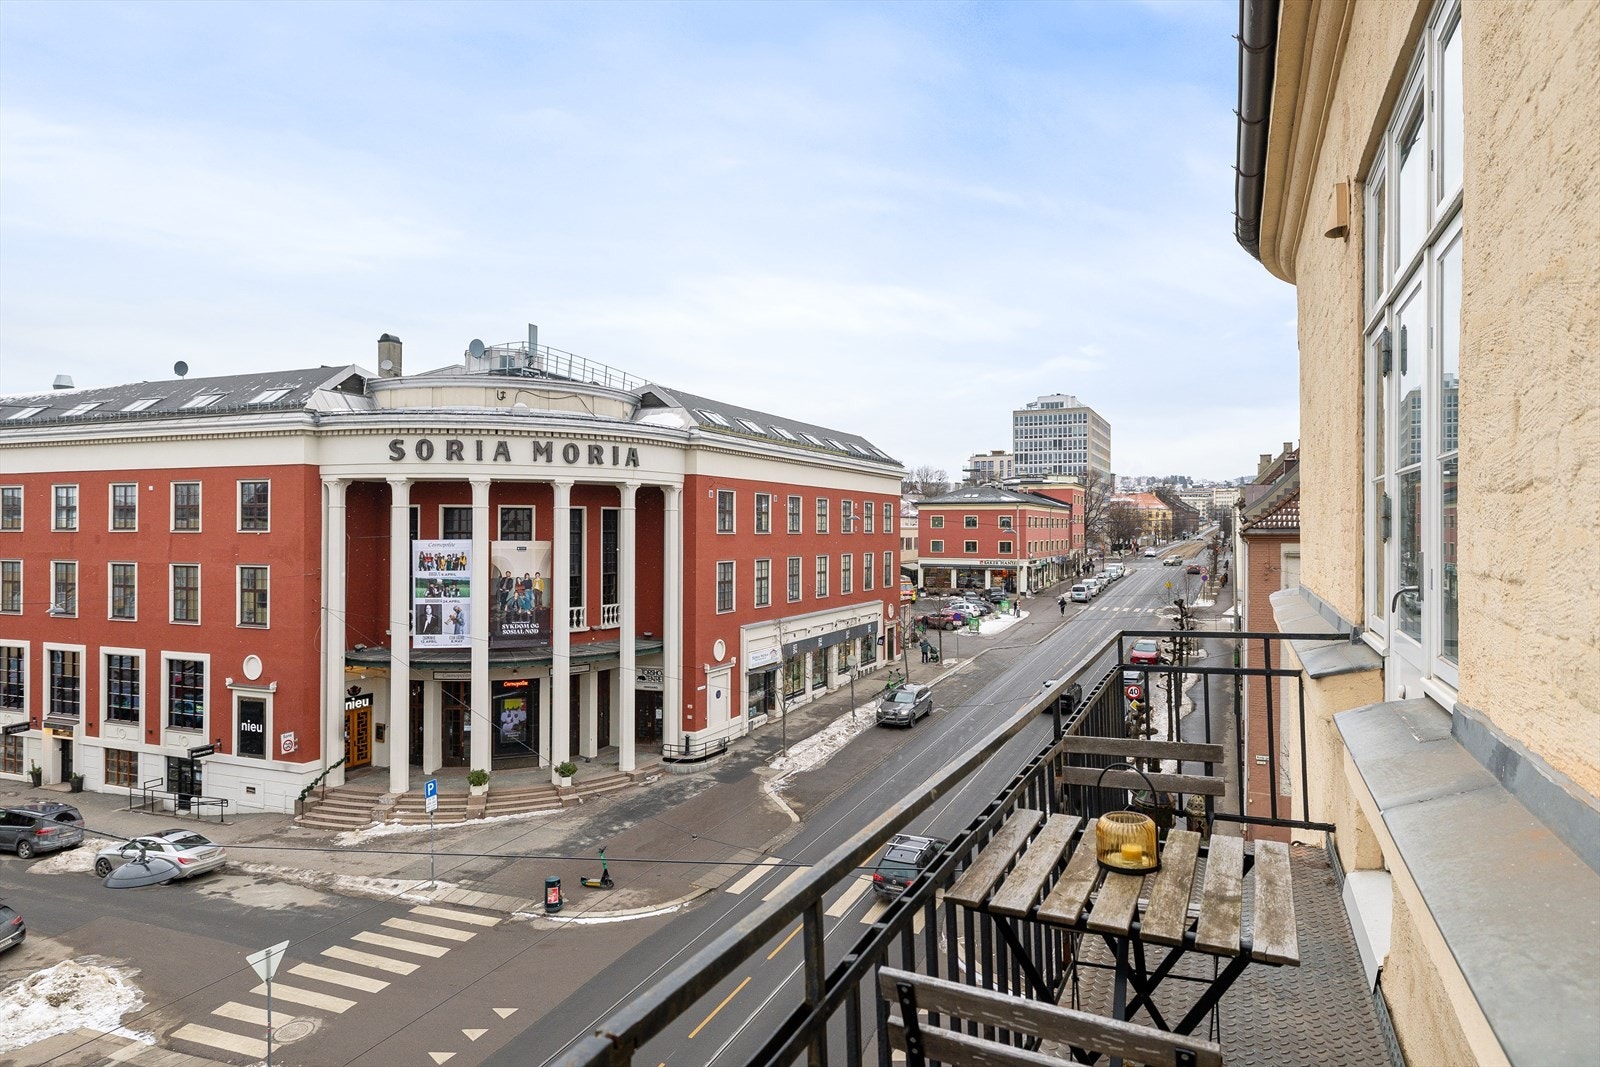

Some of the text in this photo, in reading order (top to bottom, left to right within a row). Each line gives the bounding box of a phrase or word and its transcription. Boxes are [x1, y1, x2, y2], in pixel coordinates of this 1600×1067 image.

[388, 438, 641, 468] SORIA MORIA
[503, 679, 529, 688] Cosmopolite
[1129, 688, 1139, 696] 40
[345, 697, 369, 711] nieu
[241, 719, 263, 733] nieu
[427, 782, 435, 796] P
